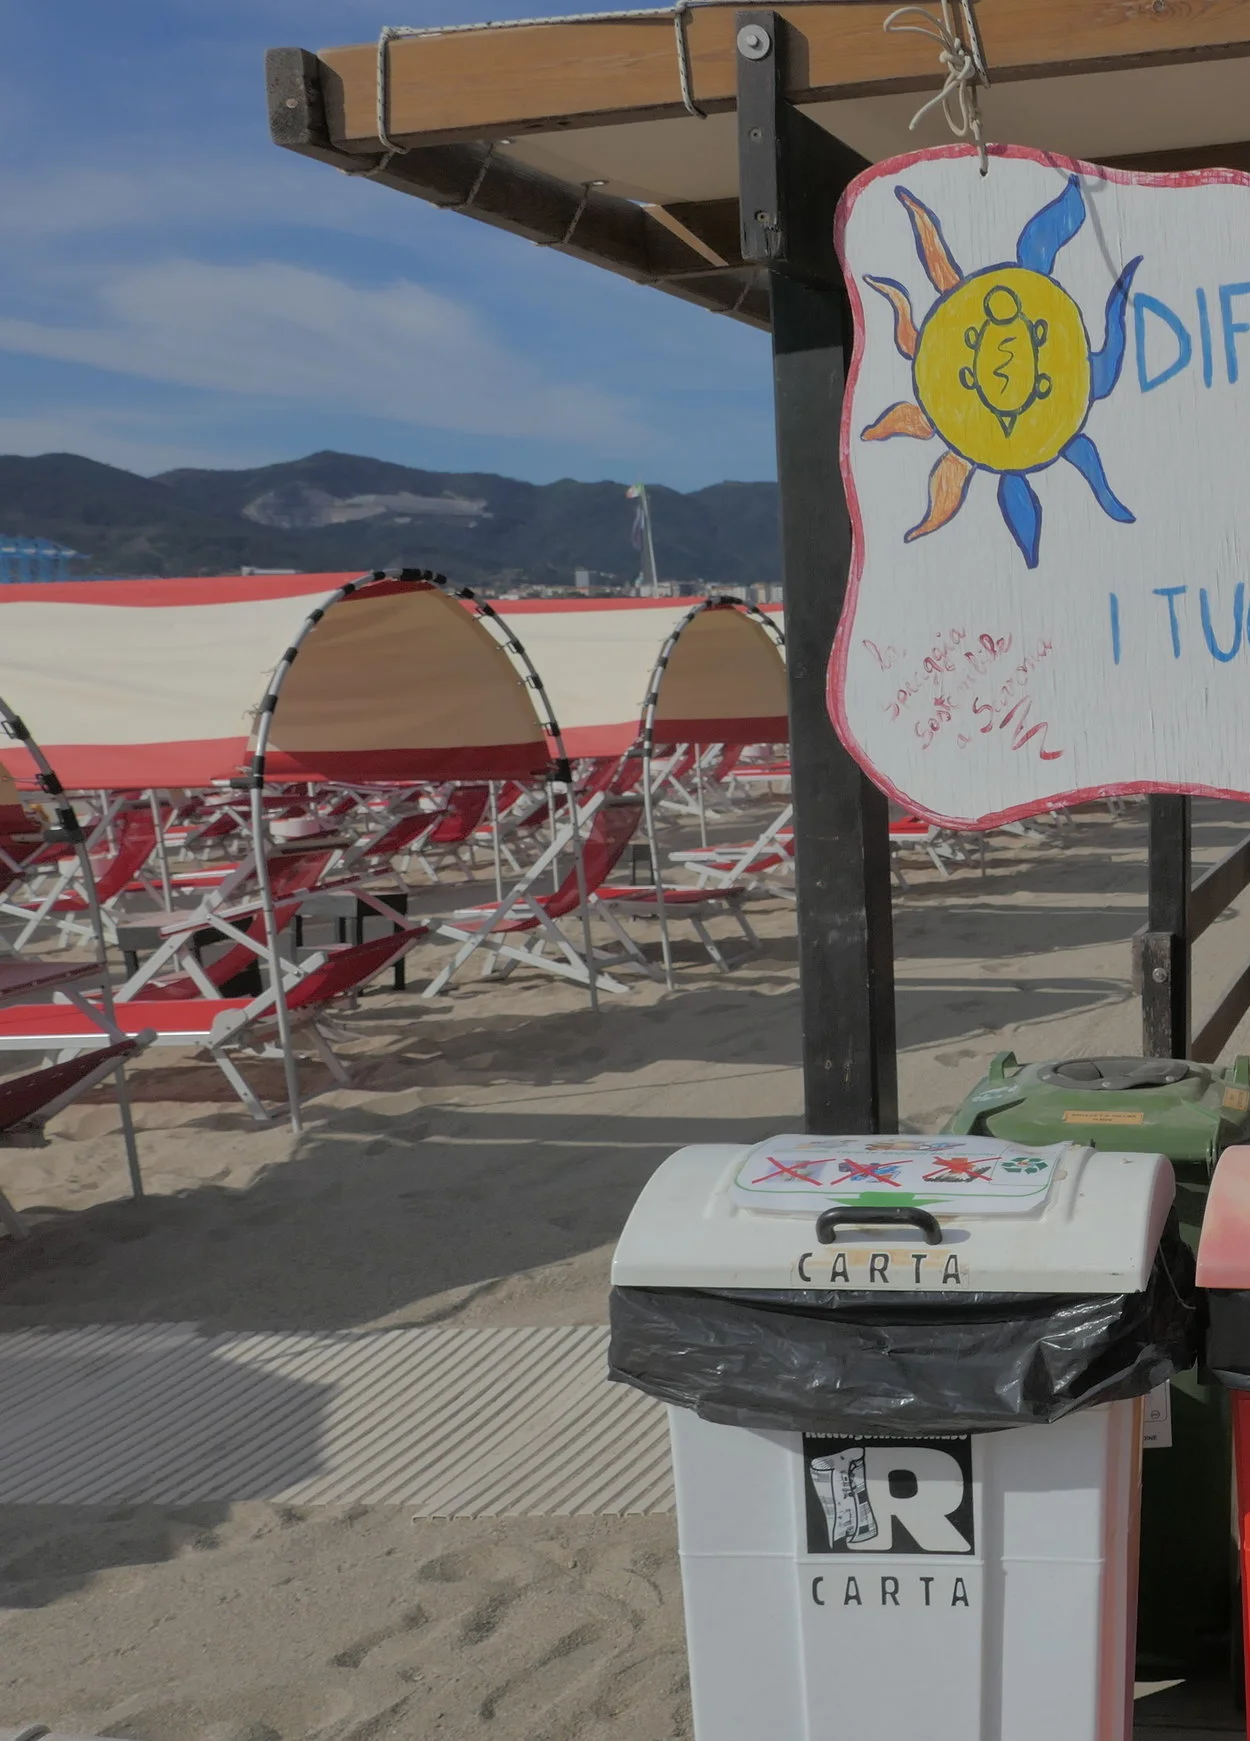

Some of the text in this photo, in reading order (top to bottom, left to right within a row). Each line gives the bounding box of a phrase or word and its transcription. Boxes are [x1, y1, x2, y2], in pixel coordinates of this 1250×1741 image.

[1110, 592, 1121, 664] I
[798, 1252, 962, 1284] CARTA
[811, 1575, 970, 1607] CARTA
